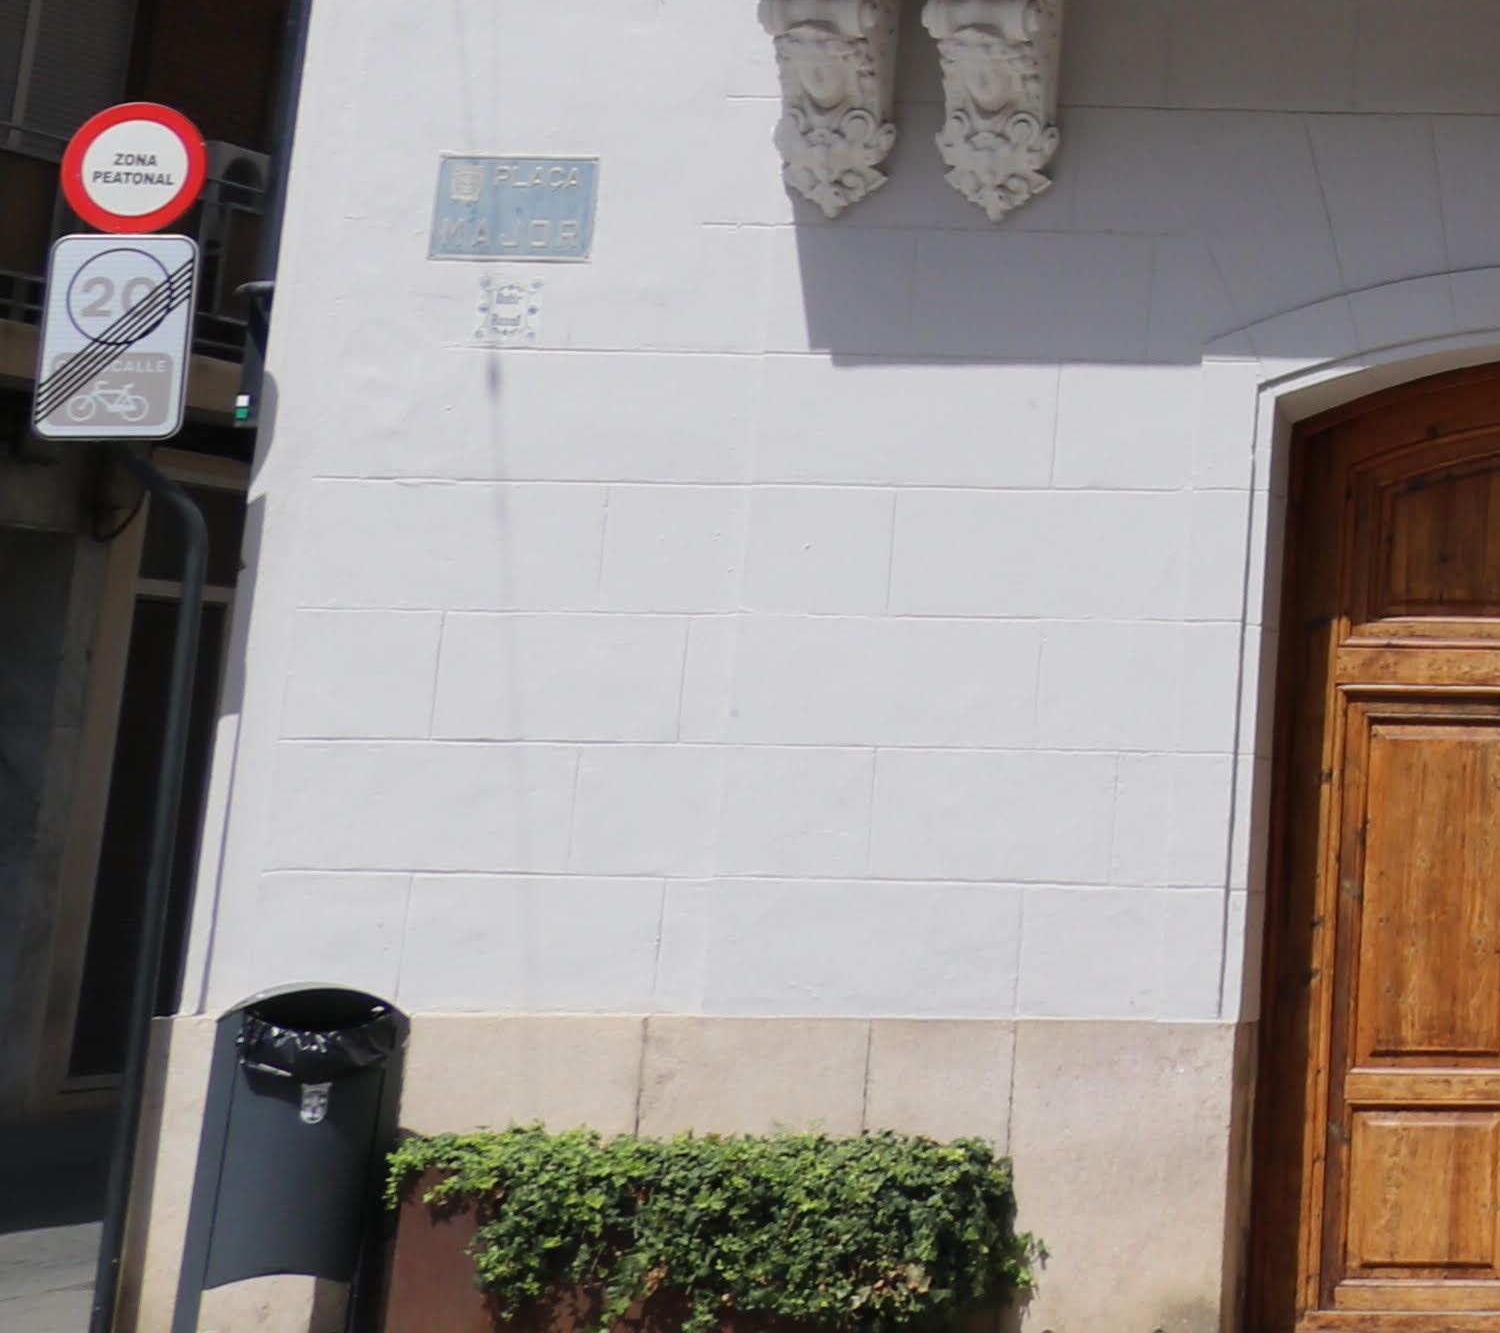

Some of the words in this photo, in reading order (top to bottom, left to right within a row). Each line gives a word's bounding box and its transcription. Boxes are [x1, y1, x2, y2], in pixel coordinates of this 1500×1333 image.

[113, 153, 158, 166] ZONA
[92, 170, 174, 186] PEATONAL
[494, 164, 581, 193] PLAÇA
[441, 218, 578, 249] MAJOR
[80, 275, 158, 318] 20
